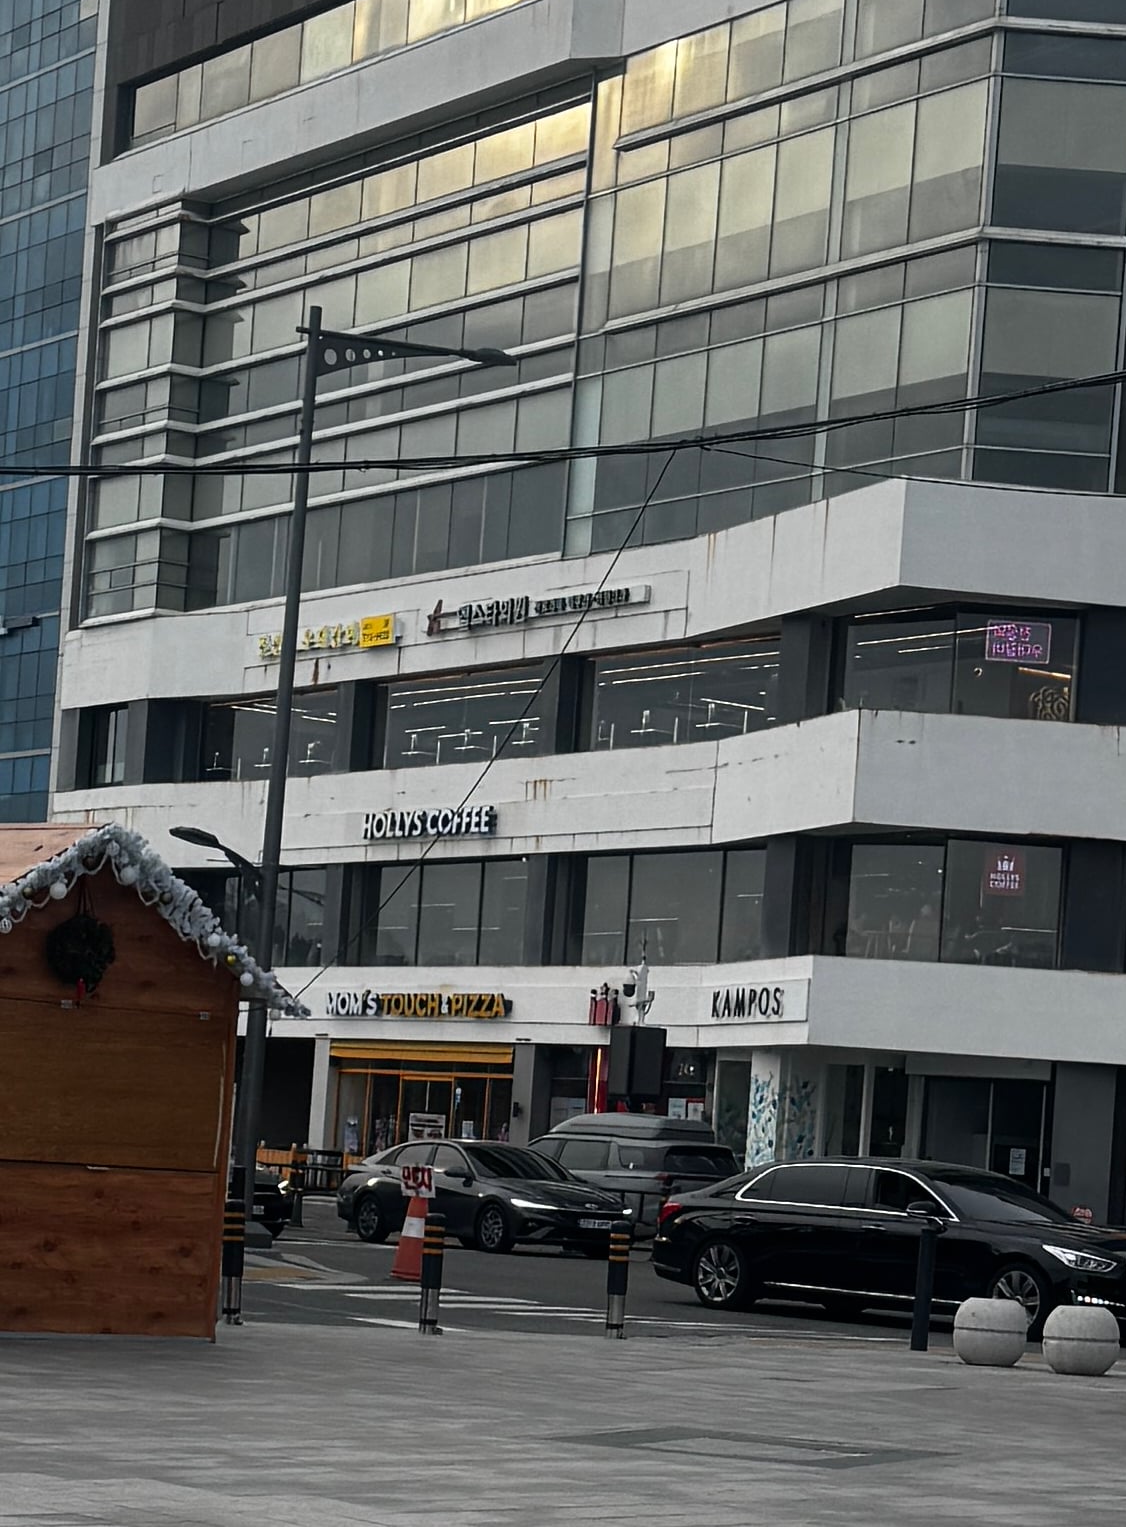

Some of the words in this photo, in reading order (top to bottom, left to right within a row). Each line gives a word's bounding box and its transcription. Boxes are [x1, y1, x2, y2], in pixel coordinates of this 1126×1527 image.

[362, 810, 422, 840] HOLLYS
[425, 805, 492, 837] COFFEE
[327, 989, 379, 1016] MOM'S
[380, 993, 440, 1018] TOUCH
[450, 992, 506, 1018] PIZZA
[711, 986, 784, 1018] KAMPOS
